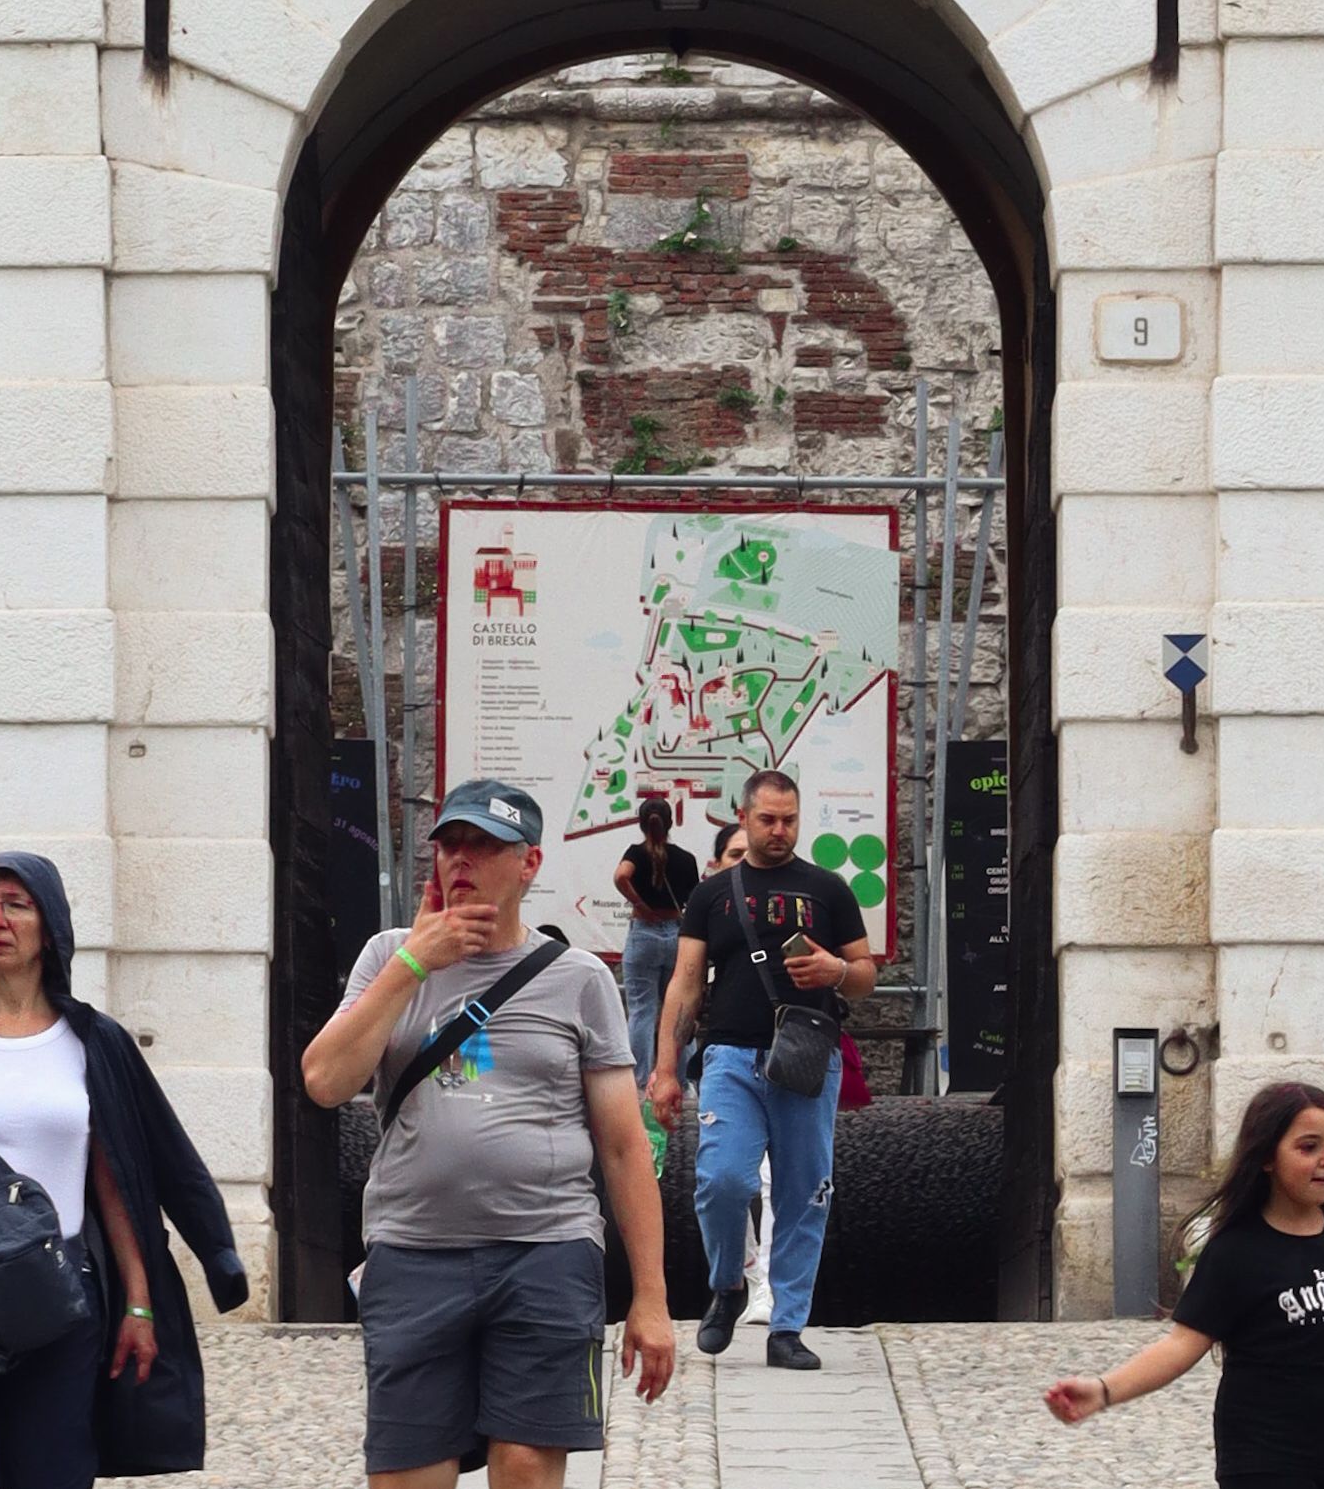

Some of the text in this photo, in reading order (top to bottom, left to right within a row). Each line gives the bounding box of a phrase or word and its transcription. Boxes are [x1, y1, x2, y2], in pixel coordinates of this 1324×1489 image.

[1133, 317, 1149, 346] 9
[472, 623, 538, 634] CASTELLO
[472, 636, 537, 647] DI BRESCIA
[348, 823, 380, 853] agosto
[592, 899, 622, 909] Museo
